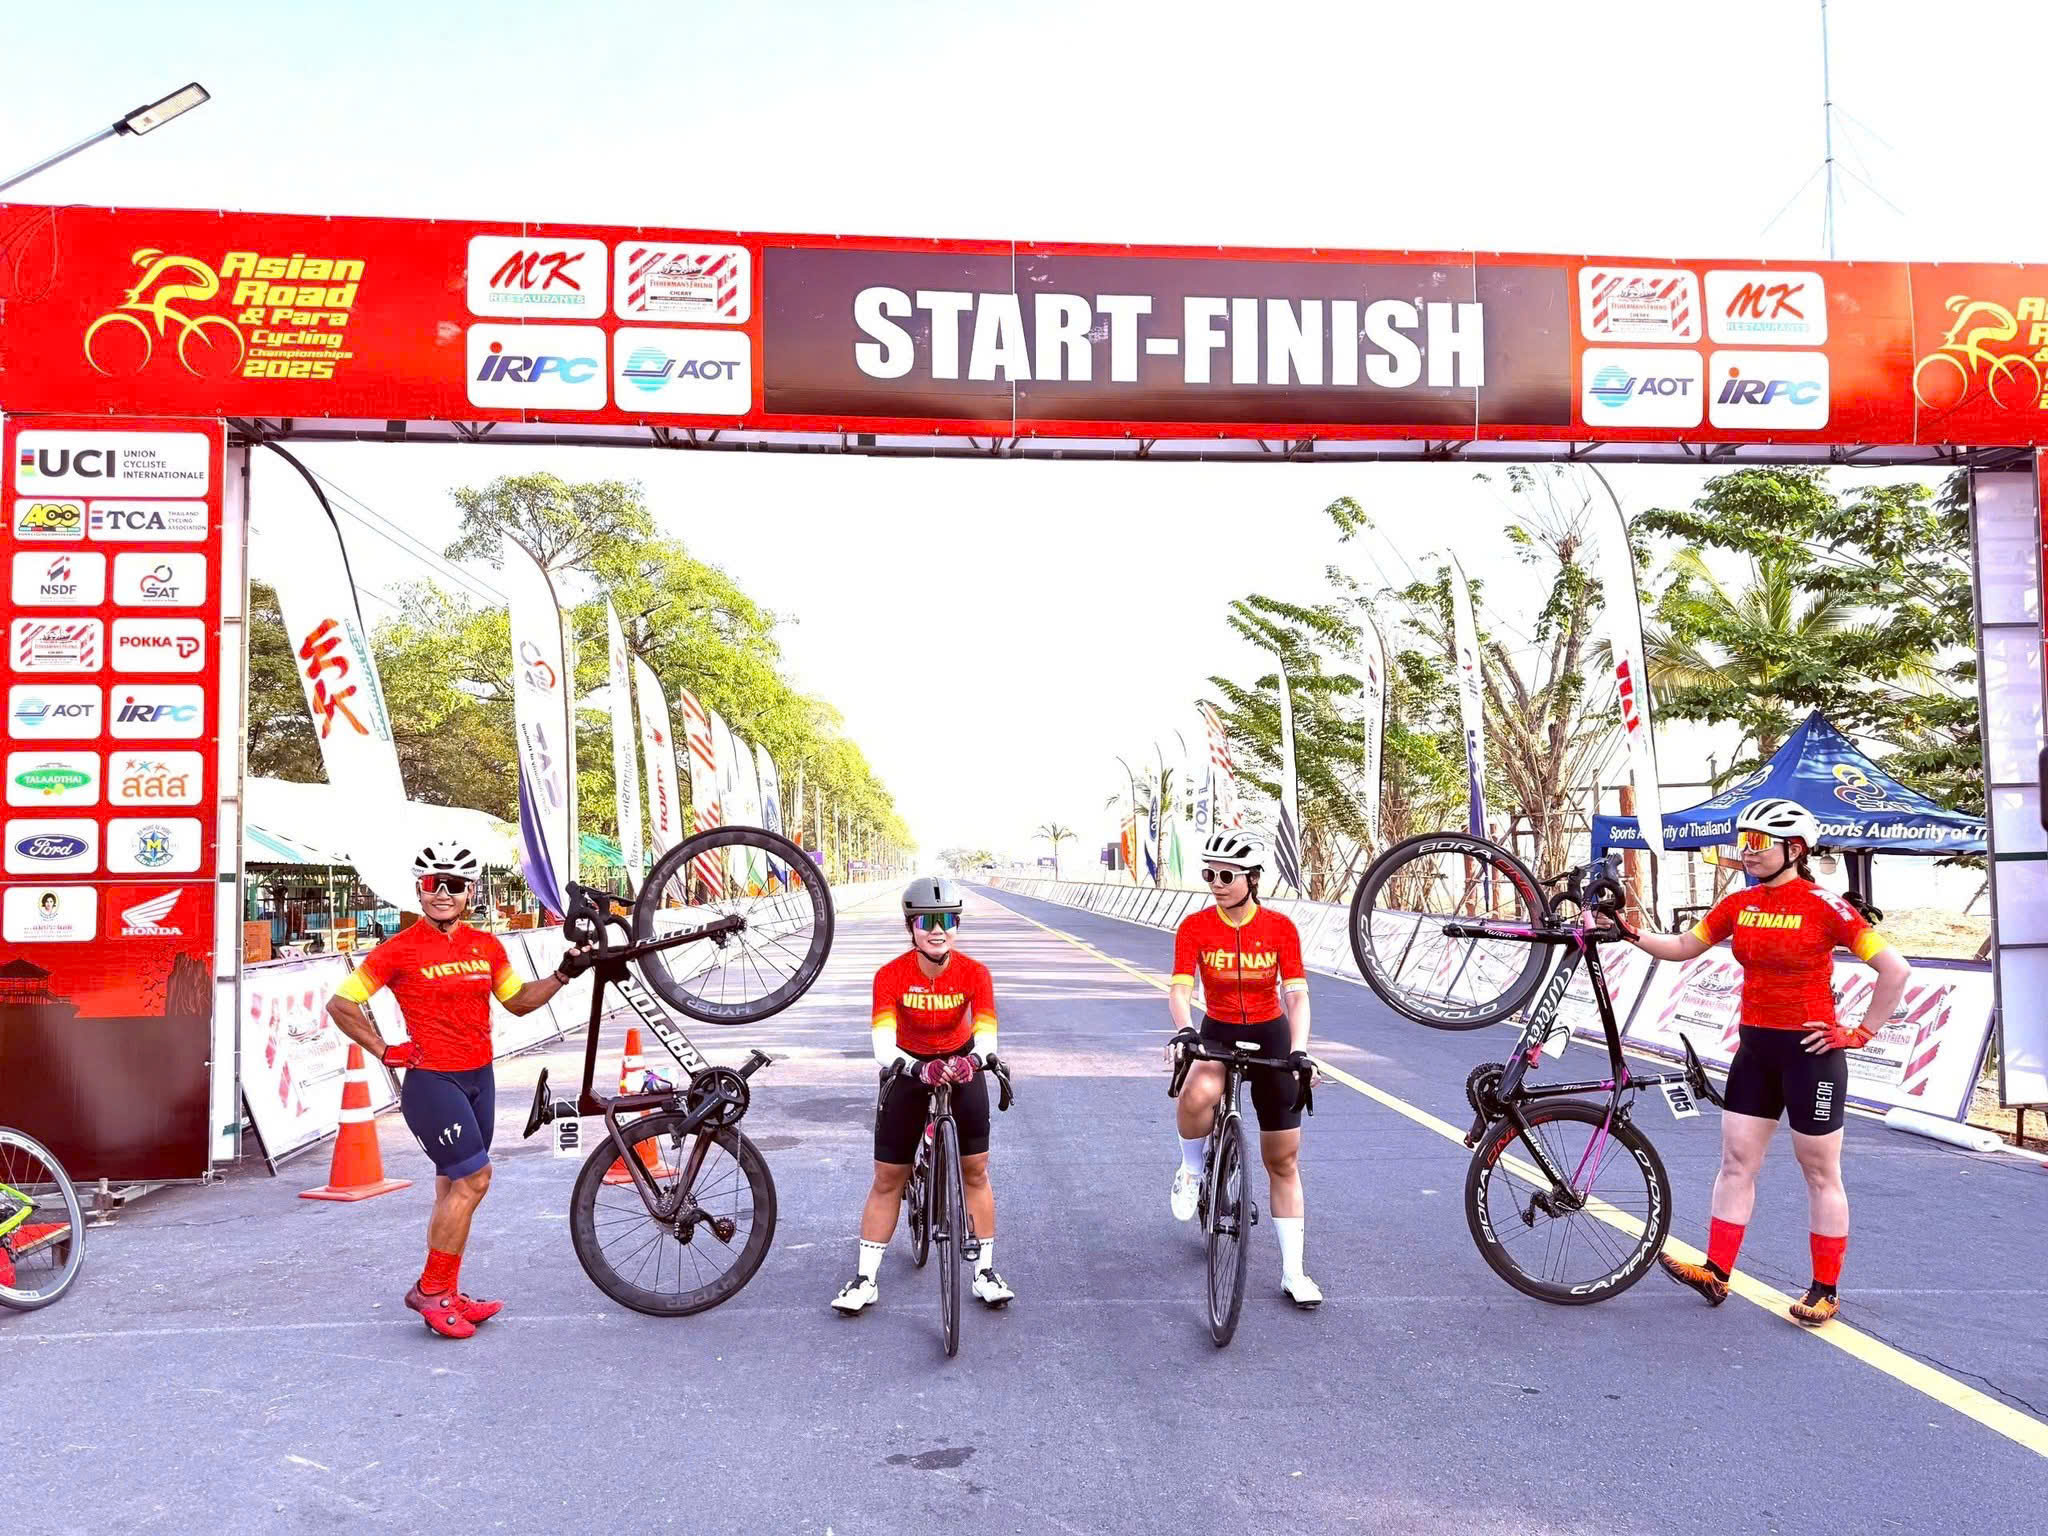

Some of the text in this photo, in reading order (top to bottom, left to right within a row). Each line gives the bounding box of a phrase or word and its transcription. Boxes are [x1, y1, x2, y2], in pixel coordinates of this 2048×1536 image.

[219, 252, 365, 281] Asian
[490, 250, 586, 291] MK
[232, 281, 359, 308] Road
[489, 293, 585, 304] RESTAURANTS
[1725, 282, 1804, 320] MK
[238, 307, 349, 326] & Para
[251, 329, 344, 348] Cycling
[853, 286, 1485, 389] START-FINISH
[249, 349, 353, 360] Championships
[243, 360, 336, 379] 2025
[678, 360, 741, 380] AOT
[1638, 377, 1694, 396] AOT
[39, 449, 115, 478] UCI
[123, 450, 156, 458] UNION
[123, 471, 204, 480] INTERNATIONALE
[106, 511, 166, 530] TCA
[40, 585, 77, 595] NSDF
[143, 583, 179, 598] SAT
[120, 637, 172, 648] POKKA
[52, 705, 95, 717] AOT
[24, 775, 82, 785] TALAADTHAI
[1610, 826, 1636, 842] Sports
[1679, 823, 1690, 838] of
[1690, 818, 1732, 837] Thailand
[1866, 823, 1946, 845] Authority
[1952, 827, 1971, 840] of
[30, 838, 73, 856] Ford
[1418, 841, 1537, 903] BORA ONE
[1737, 910, 1802, 929] VIETNAM
[121, 927, 183, 936] HONDA
[420, 959, 491, 980] VIETNAM
[1201, 948, 1278, 971] VIỆT NAM
[1361, 914, 1498, 1020] CAMPAGNOLO
[686, 998, 754, 1018] HYPER
[903, 993, 965, 1011] VIETNAM
[617, 976, 706, 1073] RAPTOR
[1666, 1085, 1694, 1113] 105
[1813, 1081, 1834, 1122] LAMEDA
[559, 1122, 579, 1151] 106
[1477, 1168, 1497, 1243] BORA
[1570, 1149, 1663, 1295] CAMPAGNOLO
